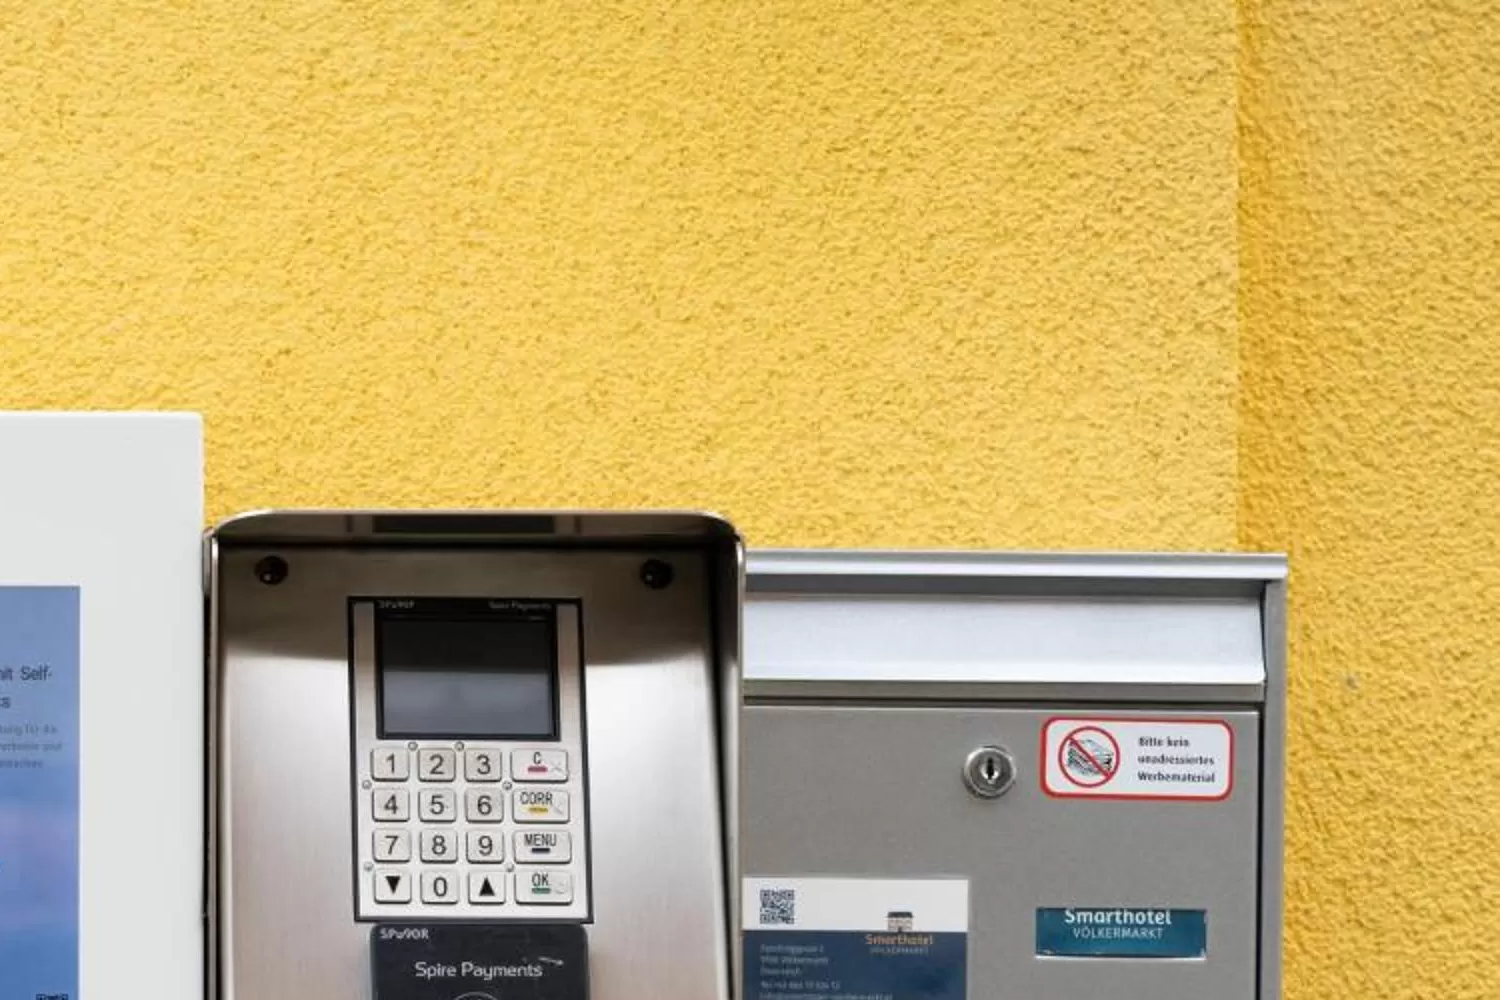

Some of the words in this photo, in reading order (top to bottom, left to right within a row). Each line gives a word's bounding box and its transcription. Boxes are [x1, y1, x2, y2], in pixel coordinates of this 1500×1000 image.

[20, 665, 52, 682] Self-
[1139, 736, 1164, 747] Bitte
[1166, 736, 1190, 747] kein
[385, 754, 397, 774] 1
[429, 754, 445, 775] 2
[476, 754, 491, 775] 3
[532, 751, 542, 765] C
[1137, 771, 1216, 783] Werbematerial
[384, 794, 399, 815] 4
[429, 794, 445, 815] 5
[476, 794, 492, 816] 6
[385, 834, 399, 856] 7
[431, 835, 447, 856] 8
[477, 834, 493, 856] 9
[523, 833, 558, 848] MENU
[433, 876, 448, 897] 0
[531, 872, 550, 887] OK
[1064, 909, 1172, 925] Smarthotel
[1073, 926, 1164, 940] VÖLKERMARKT
[415, 961, 457, 980] Spire
[461, 961, 544, 981] Payments
